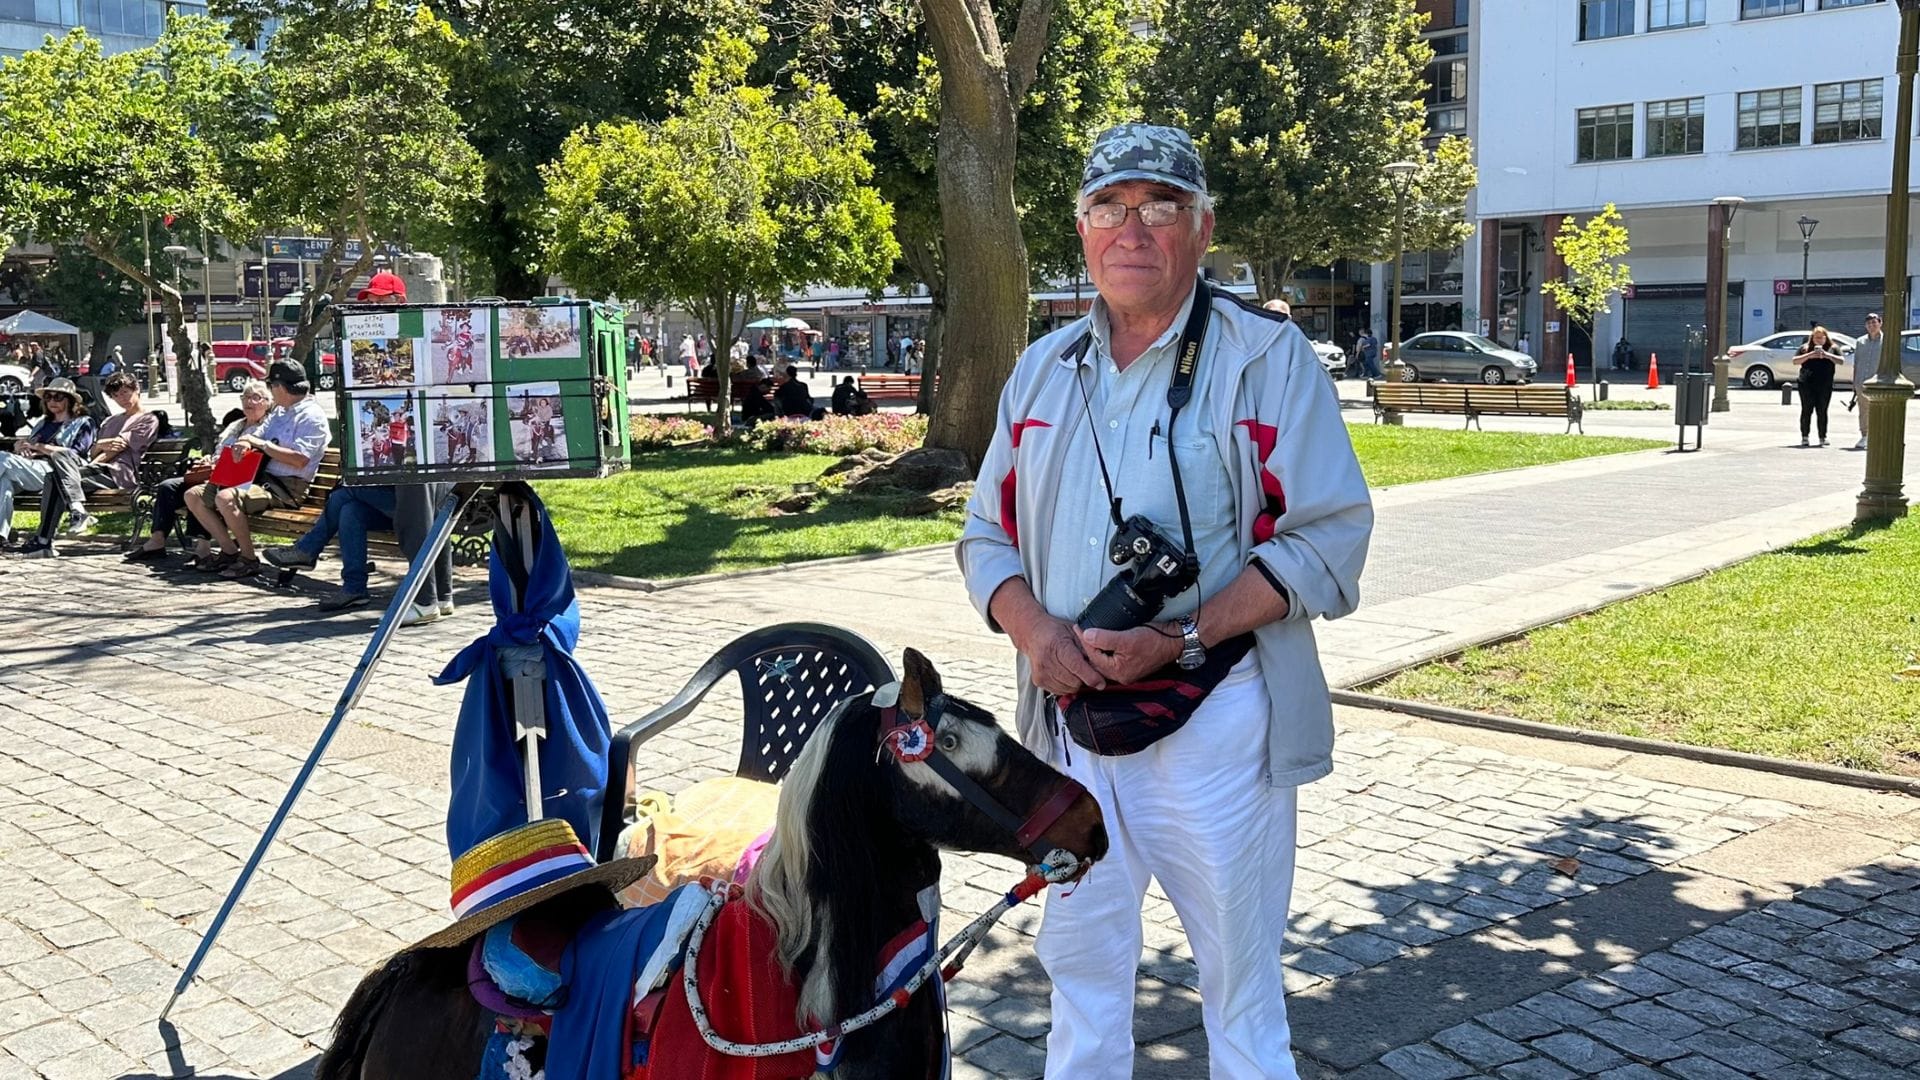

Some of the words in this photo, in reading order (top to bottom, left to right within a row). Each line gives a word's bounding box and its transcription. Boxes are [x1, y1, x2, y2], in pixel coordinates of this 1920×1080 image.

[345, 242, 359, 251] DE
[1053, 301, 1075, 312] FOTO
[1180, 341, 1198, 374] Nikon
